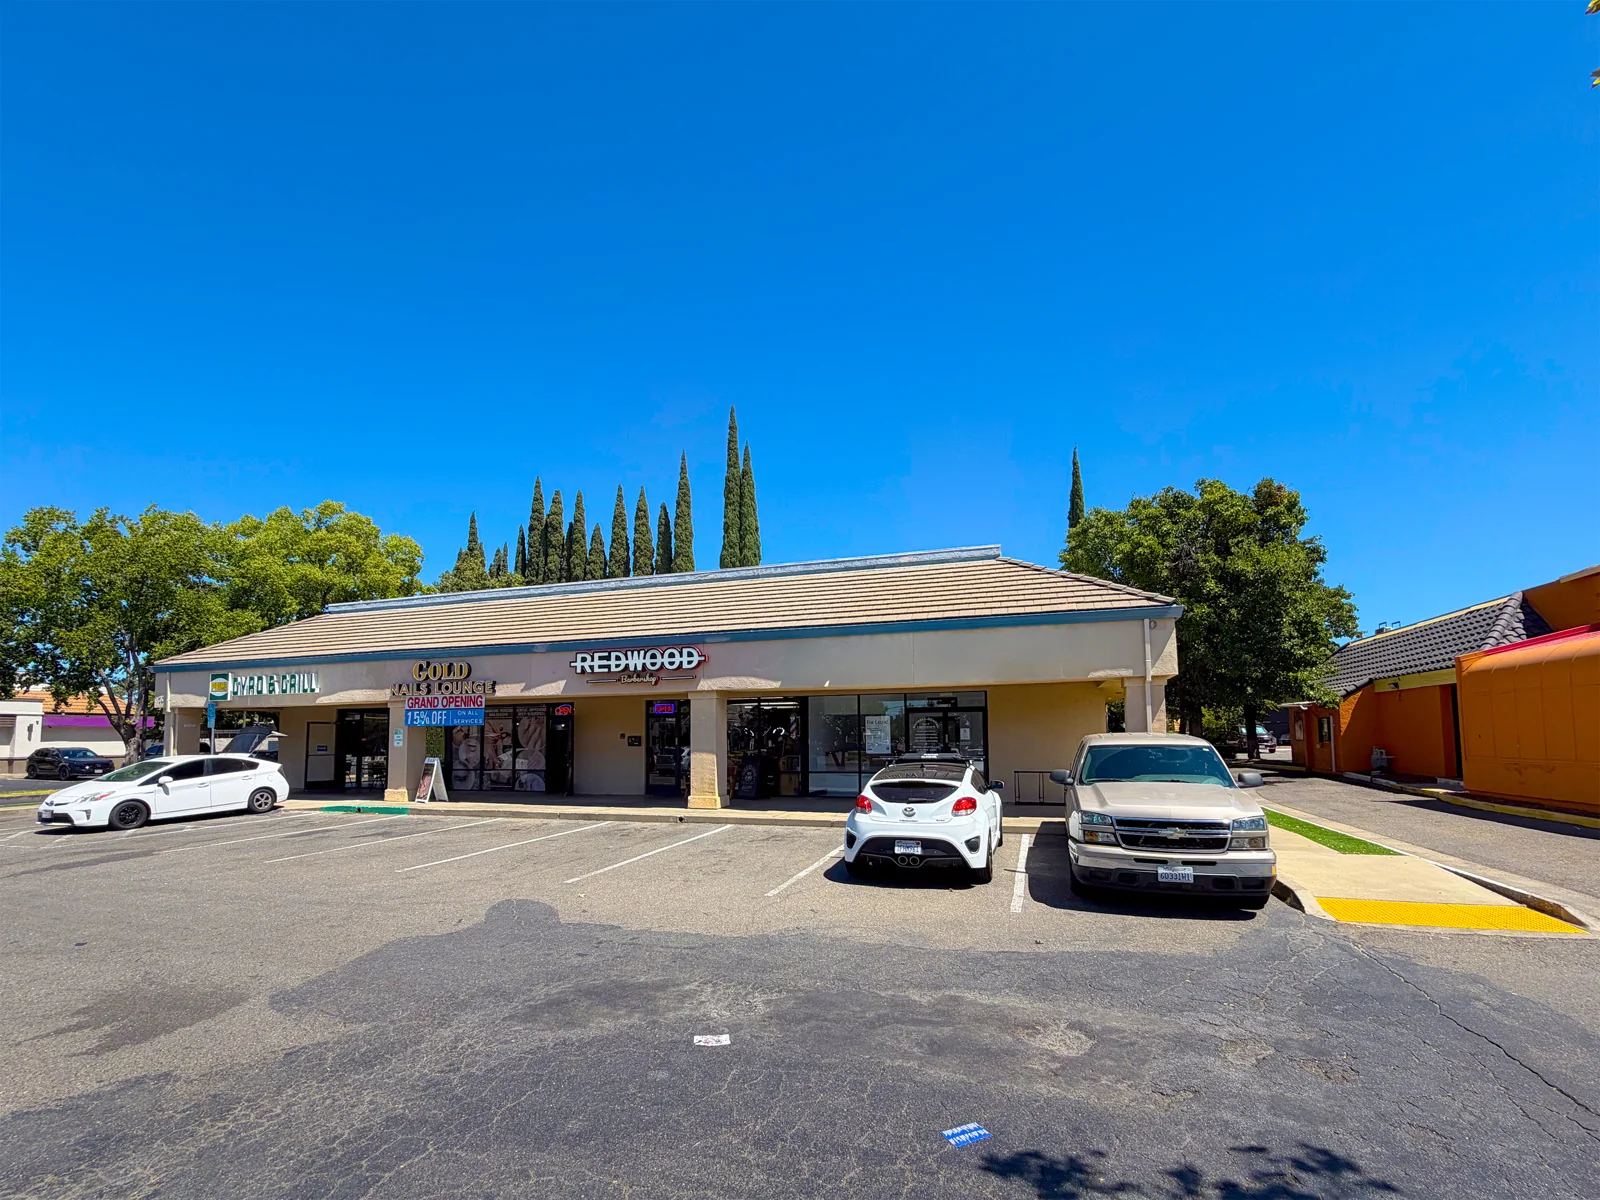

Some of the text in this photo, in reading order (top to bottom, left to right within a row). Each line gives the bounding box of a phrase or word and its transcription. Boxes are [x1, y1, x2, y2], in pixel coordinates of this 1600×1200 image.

[571, 647, 704, 674] REDWOOD
[413, 660, 471, 681] GOLD
[232, 673, 318, 696] GYRO & GRILL
[620, 672, 658, 686] Barbershop
[389, 681, 494, 697] NAILS LOUNGE
[407, 695, 484, 709] GRAND OPENING
[407, 710, 447, 725] 15% OFF
[554, 705, 572, 715] OPEN
